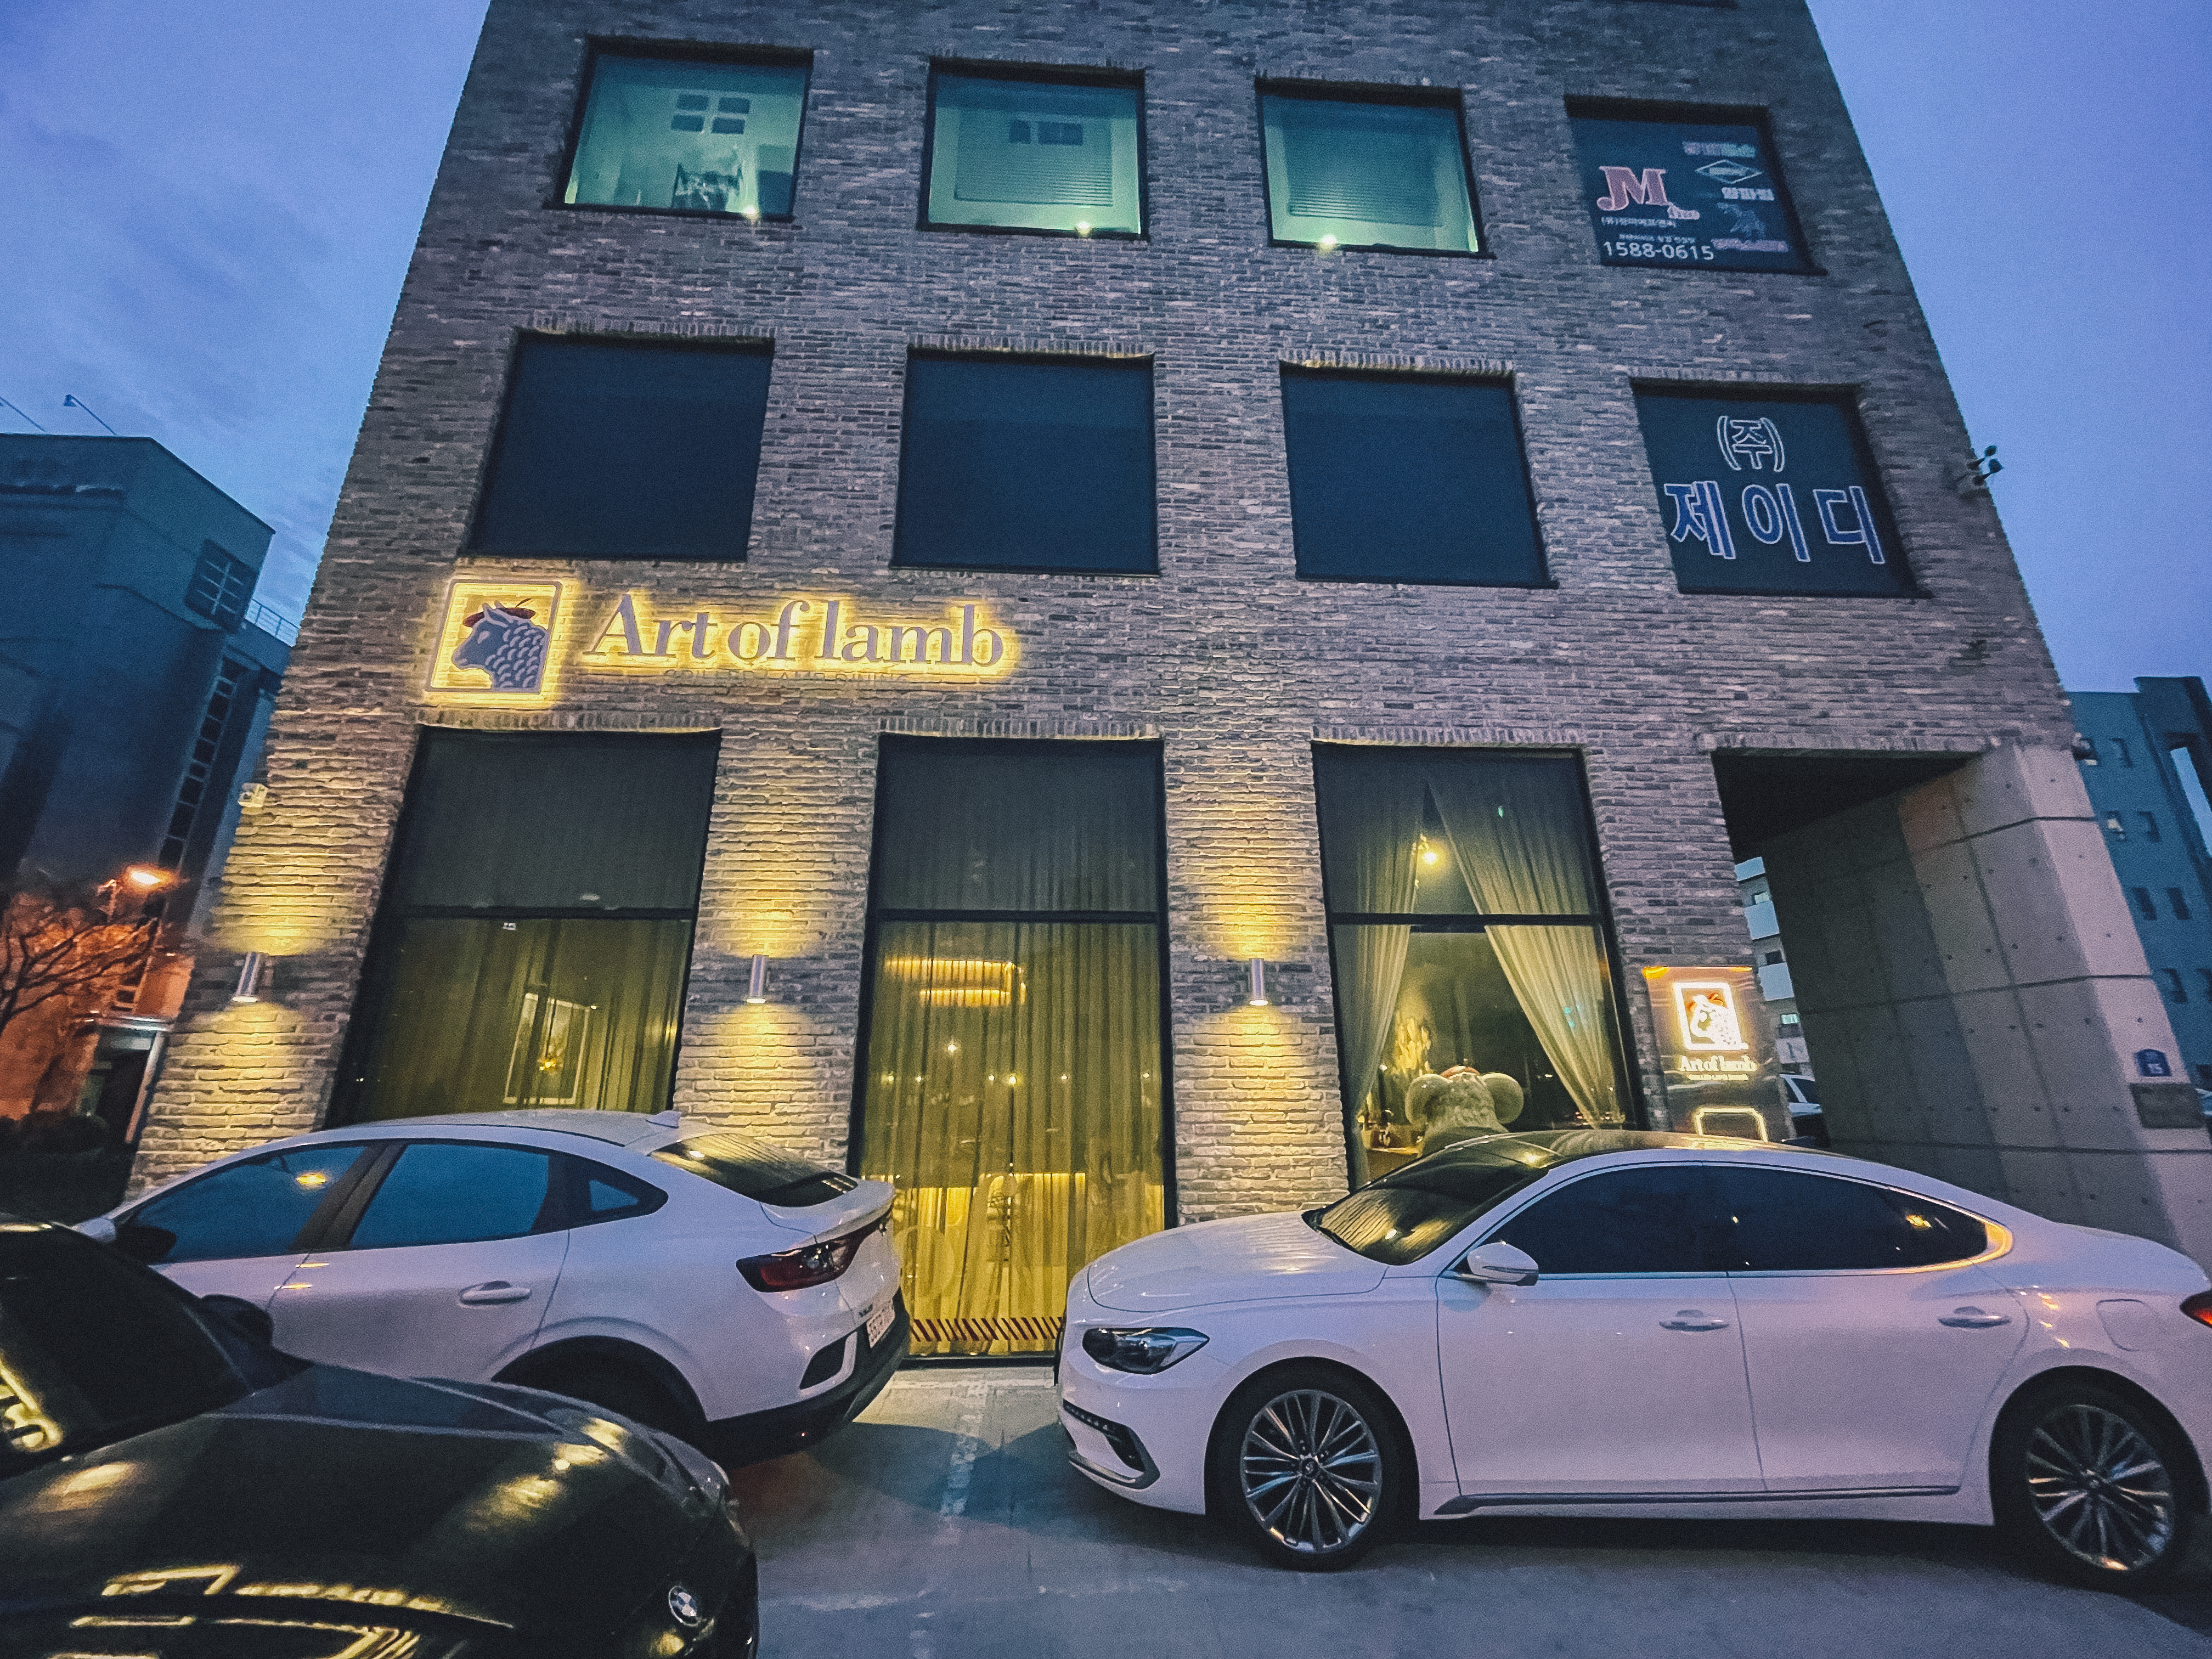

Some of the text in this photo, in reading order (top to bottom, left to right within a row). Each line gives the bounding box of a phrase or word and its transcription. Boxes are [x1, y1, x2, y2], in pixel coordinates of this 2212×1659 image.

[1603, 241, 1714, 261] 1588-0615
[1717, 415, 1785, 472] (주)
[1664, 480, 1886, 565] 제이디
[583, 593, 1004, 667] Art of lamb
